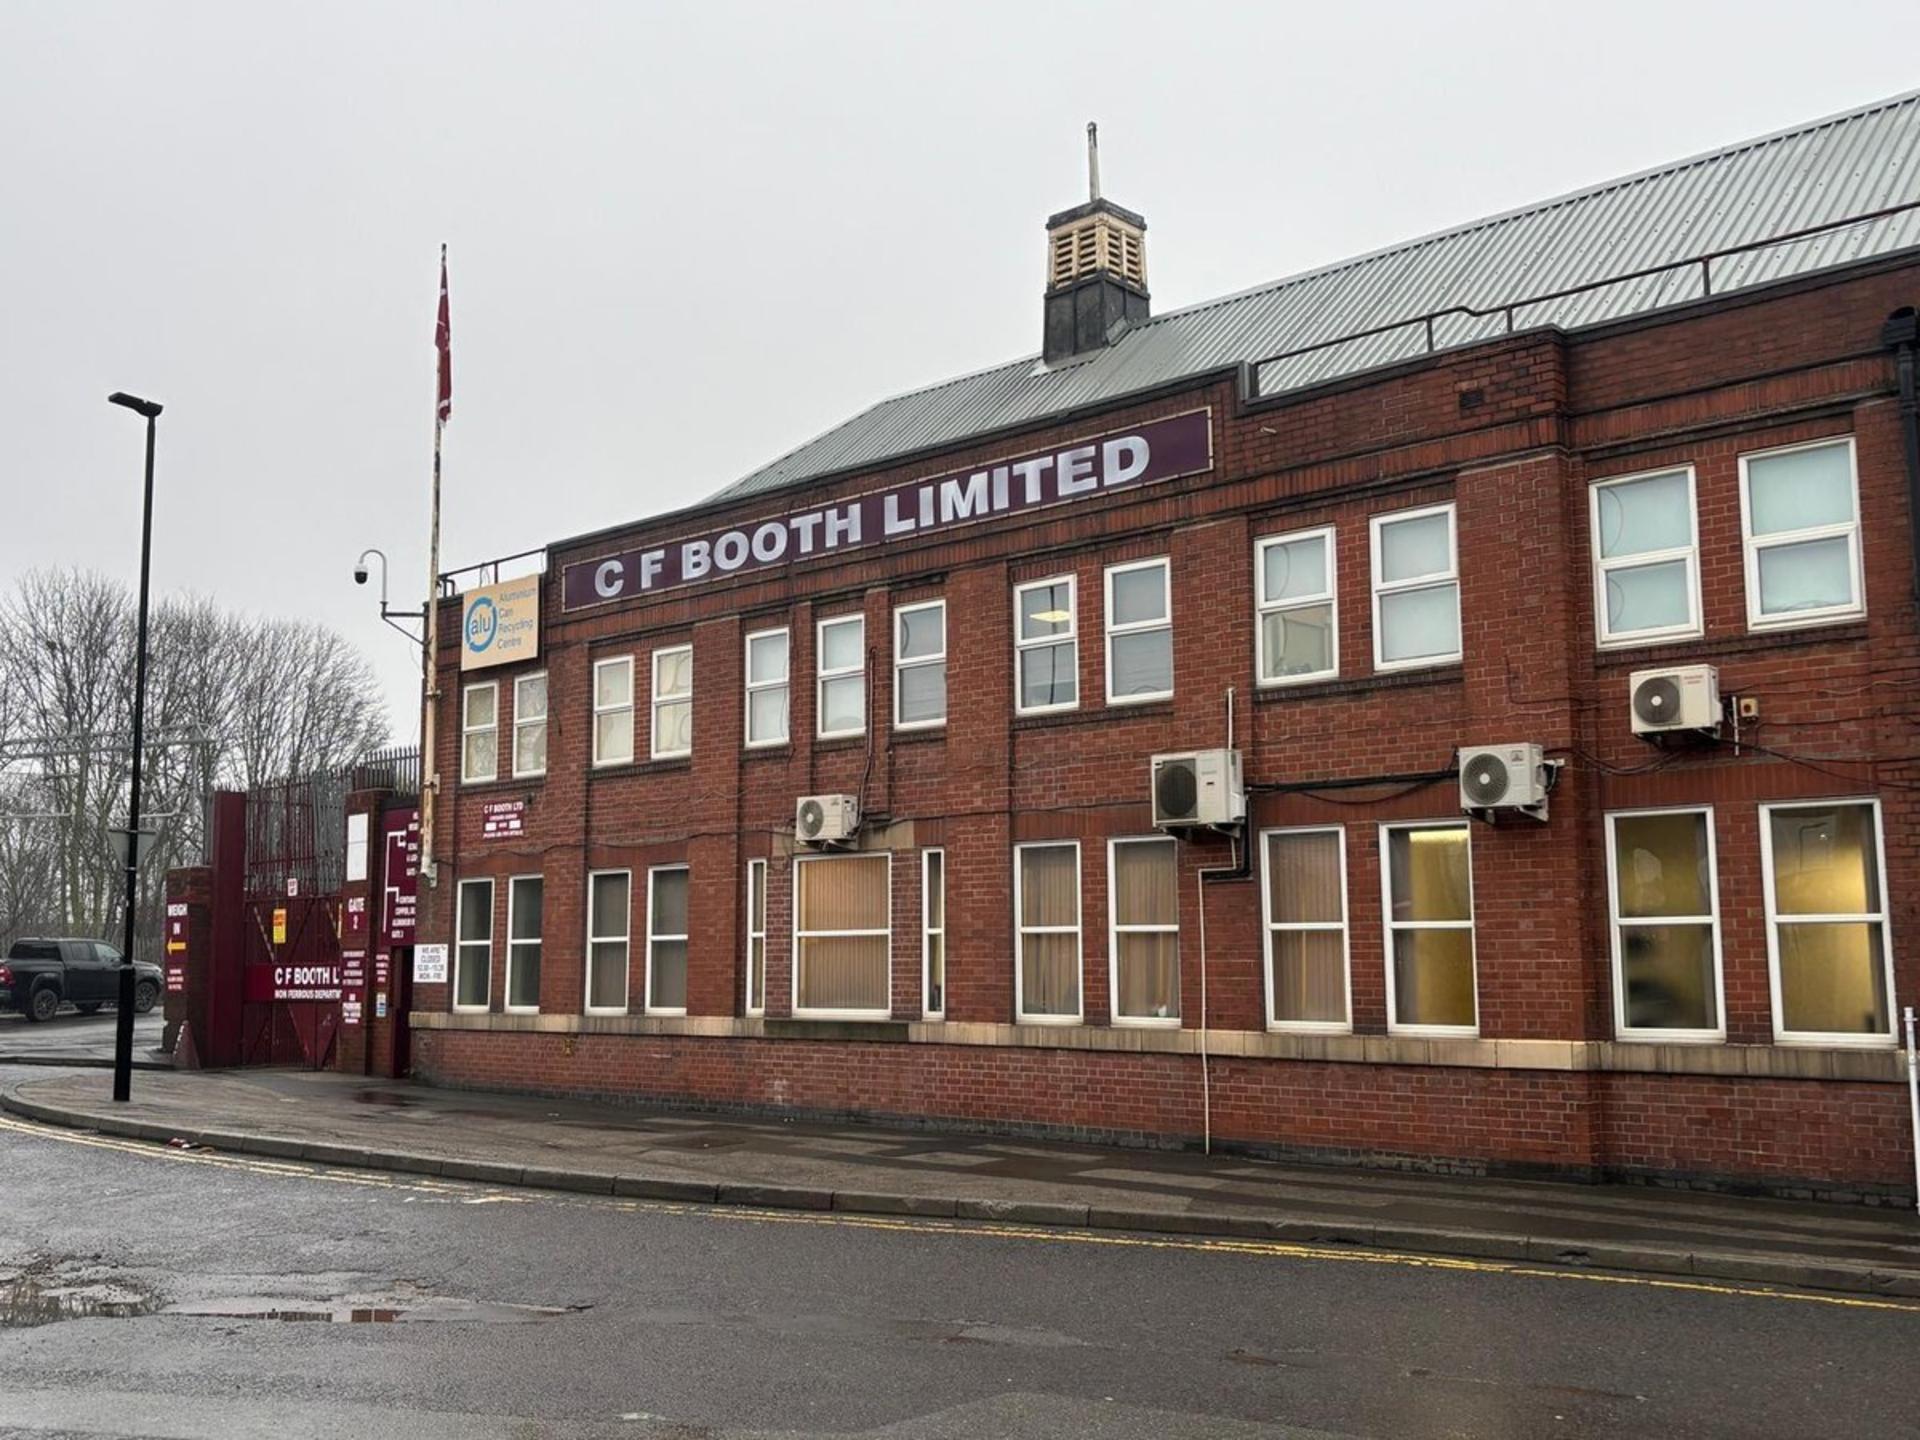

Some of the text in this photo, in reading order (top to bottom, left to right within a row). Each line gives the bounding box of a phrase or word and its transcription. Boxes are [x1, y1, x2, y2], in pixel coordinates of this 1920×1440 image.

[595, 435, 1150, 597] C F BOOTH LIMITED
[471, 613, 491, 637] alu
[275, 967, 283, 985] C
[285, 967, 292, 985] F
[294, 966, 330, 985] BOOTH
